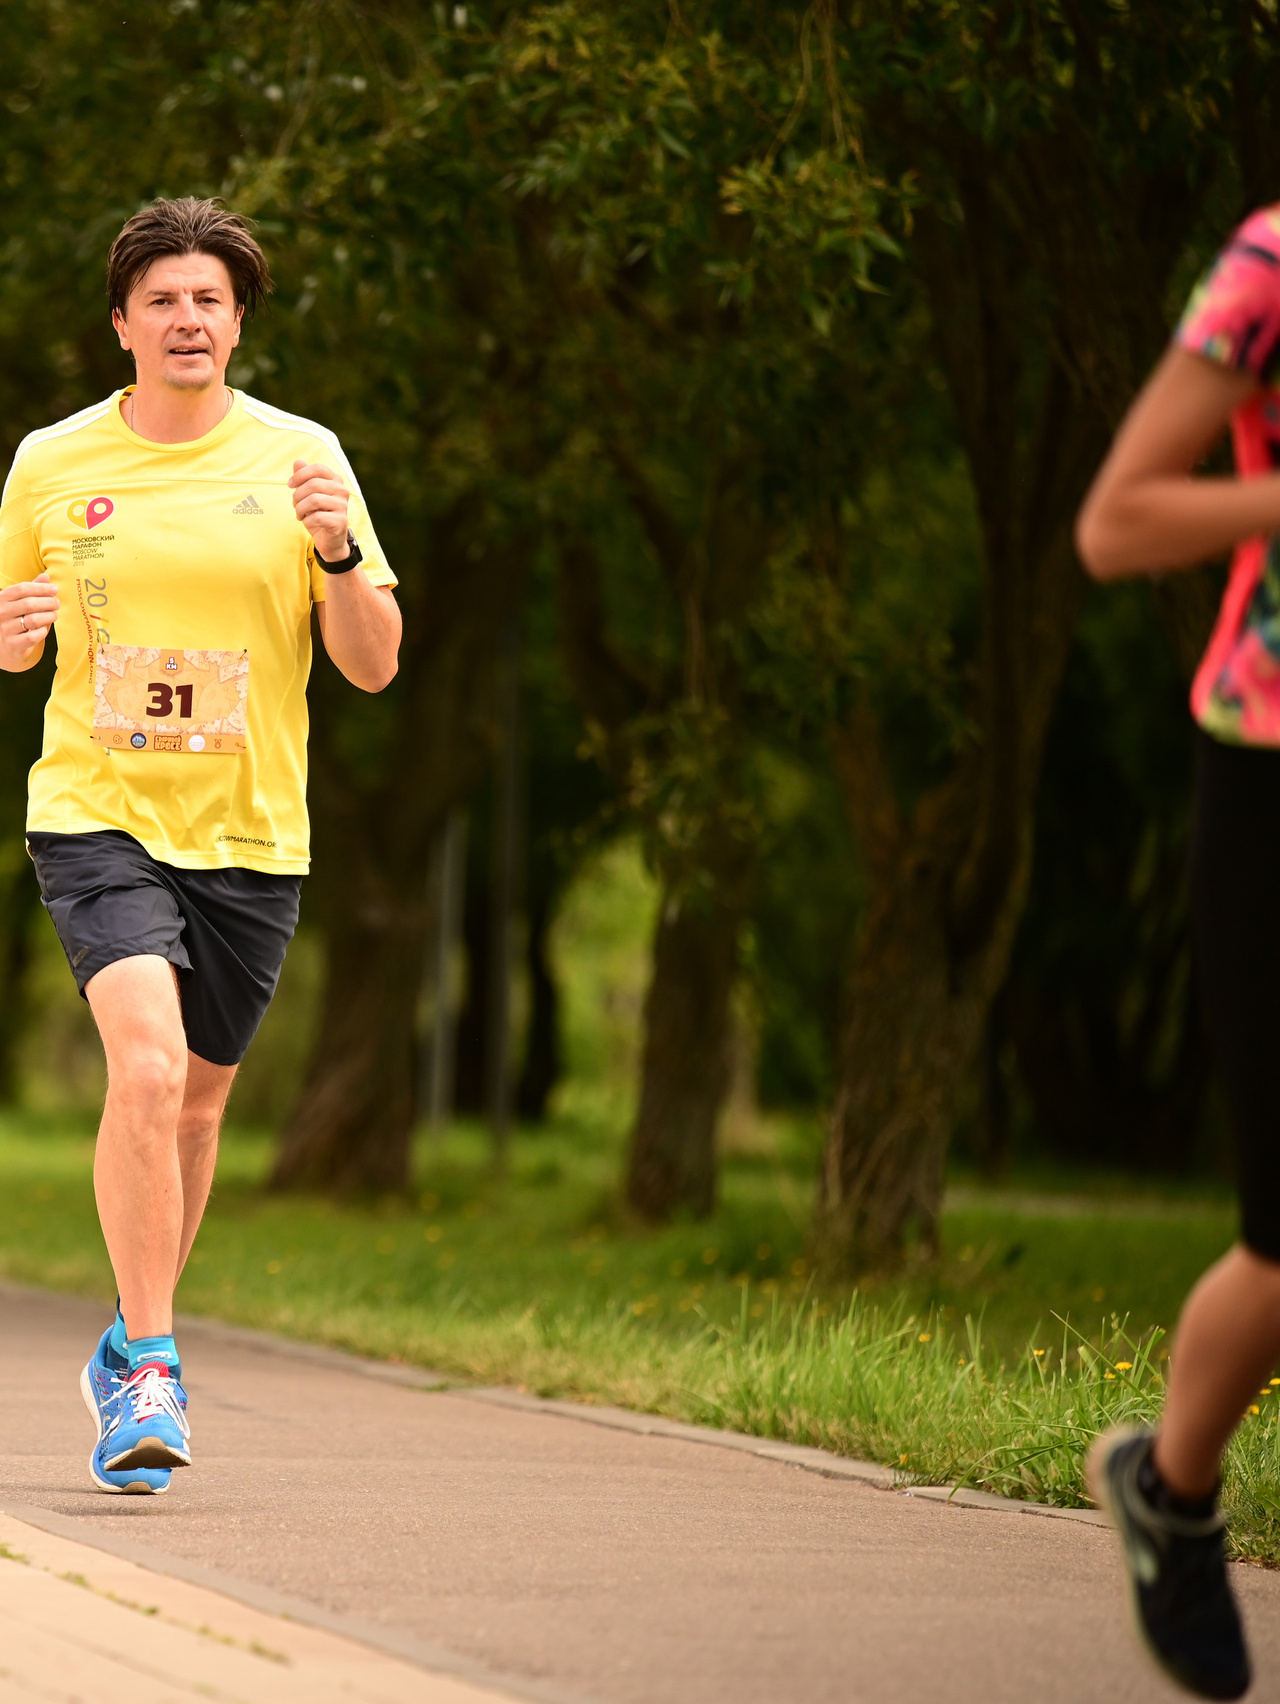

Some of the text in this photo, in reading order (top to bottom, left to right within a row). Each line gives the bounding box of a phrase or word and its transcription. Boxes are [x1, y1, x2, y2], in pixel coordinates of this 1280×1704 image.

[72, 534, 115, 545] МОСКОВСКИЙ
[72, 542, 102, 551] МАРАФОН
[72, 548, 98, 557] MOSCOW
[73, 553, 105, 561] MARATHON
[76, 578, 94, 685] MOSCOWMARATHON.ORG
[145, 682, 194, 719] 31
